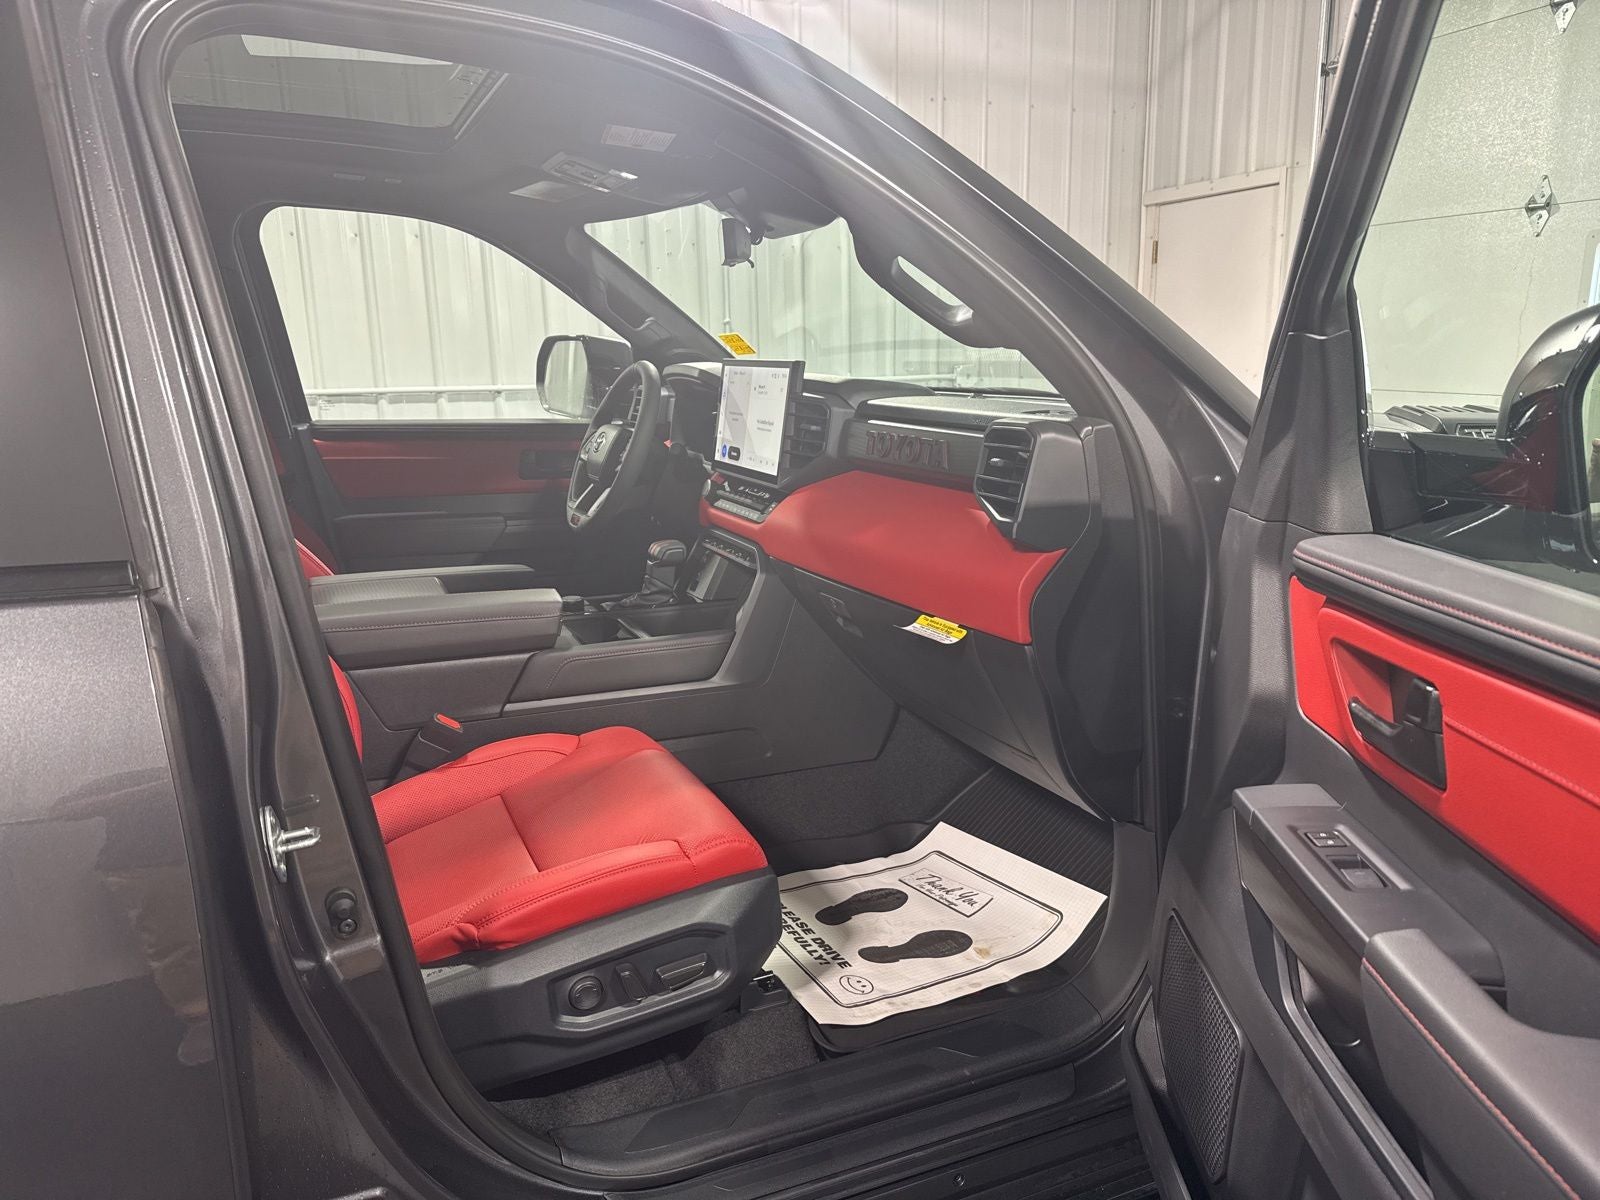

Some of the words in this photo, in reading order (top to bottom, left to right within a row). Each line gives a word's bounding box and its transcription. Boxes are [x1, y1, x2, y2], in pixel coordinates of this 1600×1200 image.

[866, 430, 951, 471] TOYOTA
[915, 873, 964, 894] Thank
[955, 891, 979, 907] You
[811, 937, 852, 969] DRIVE
